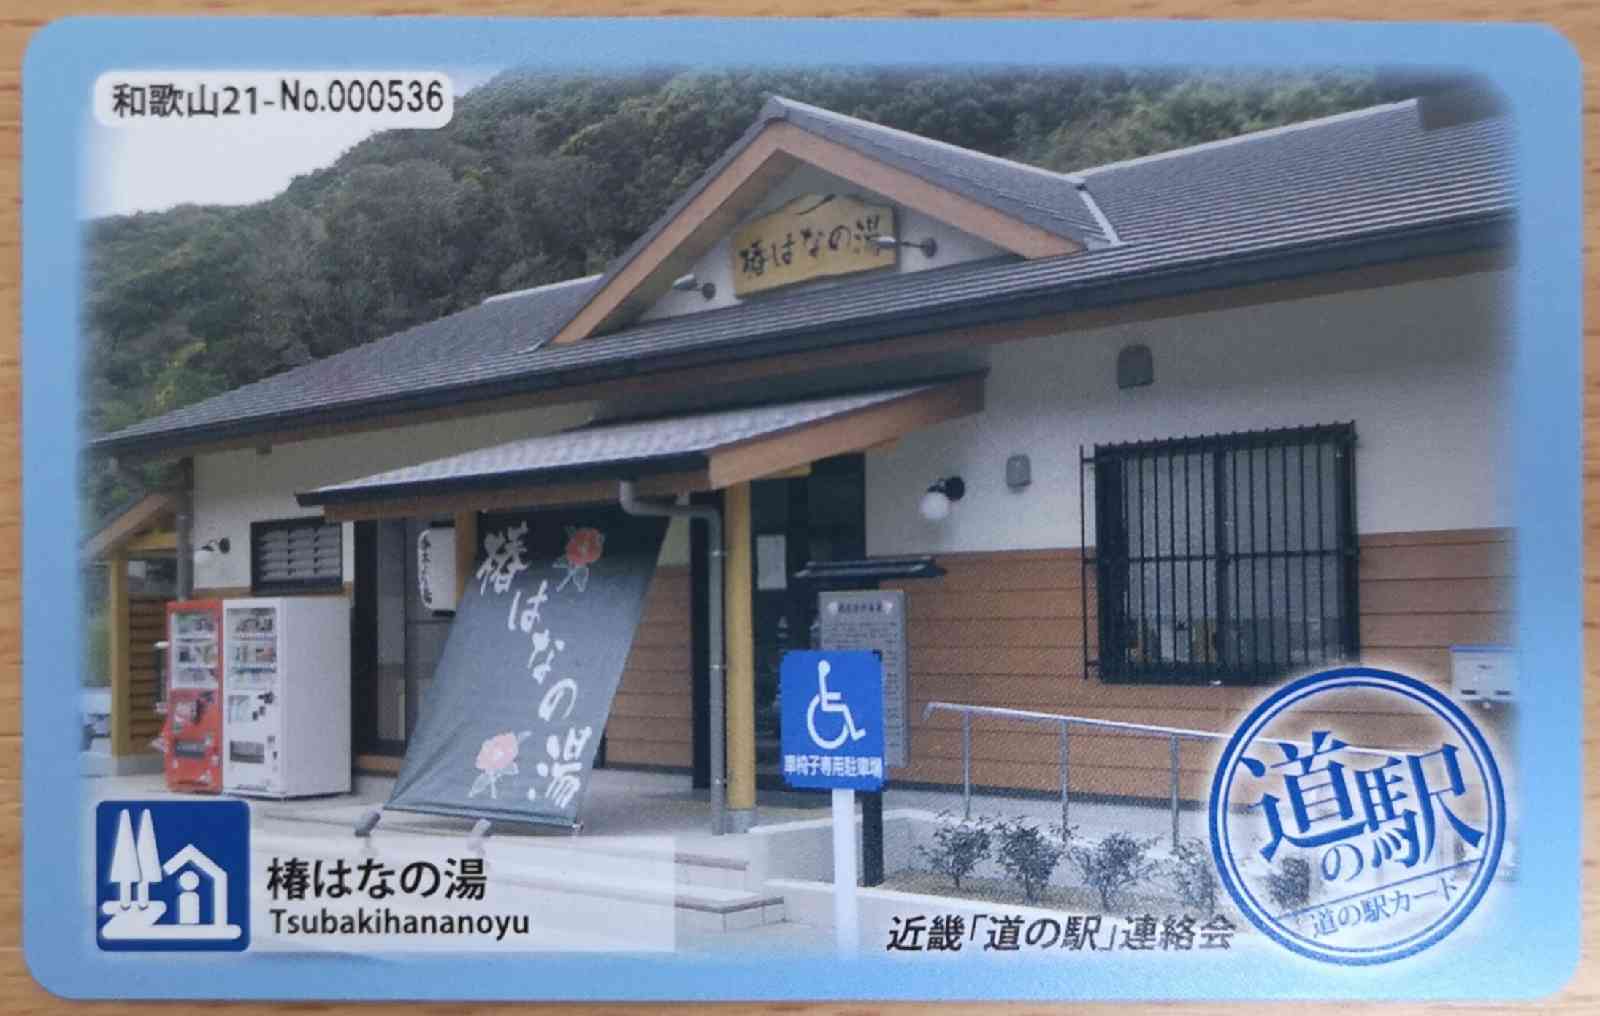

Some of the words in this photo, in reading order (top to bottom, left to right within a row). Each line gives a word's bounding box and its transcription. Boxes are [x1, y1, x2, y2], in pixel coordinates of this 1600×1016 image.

[112, 79, 444, 118] 和歌山21-No.000536
[476, 521, 593, 808] 椿はなの湯
[266, 857, 487, 901] 椿はなの湯
[270, 907, 530, 941] Tsubakihananoyu
[1311, 877, 1459, 938] 道の駅カード
[886, 913, 1236, 952] 近畿「道の駅」連絡会
